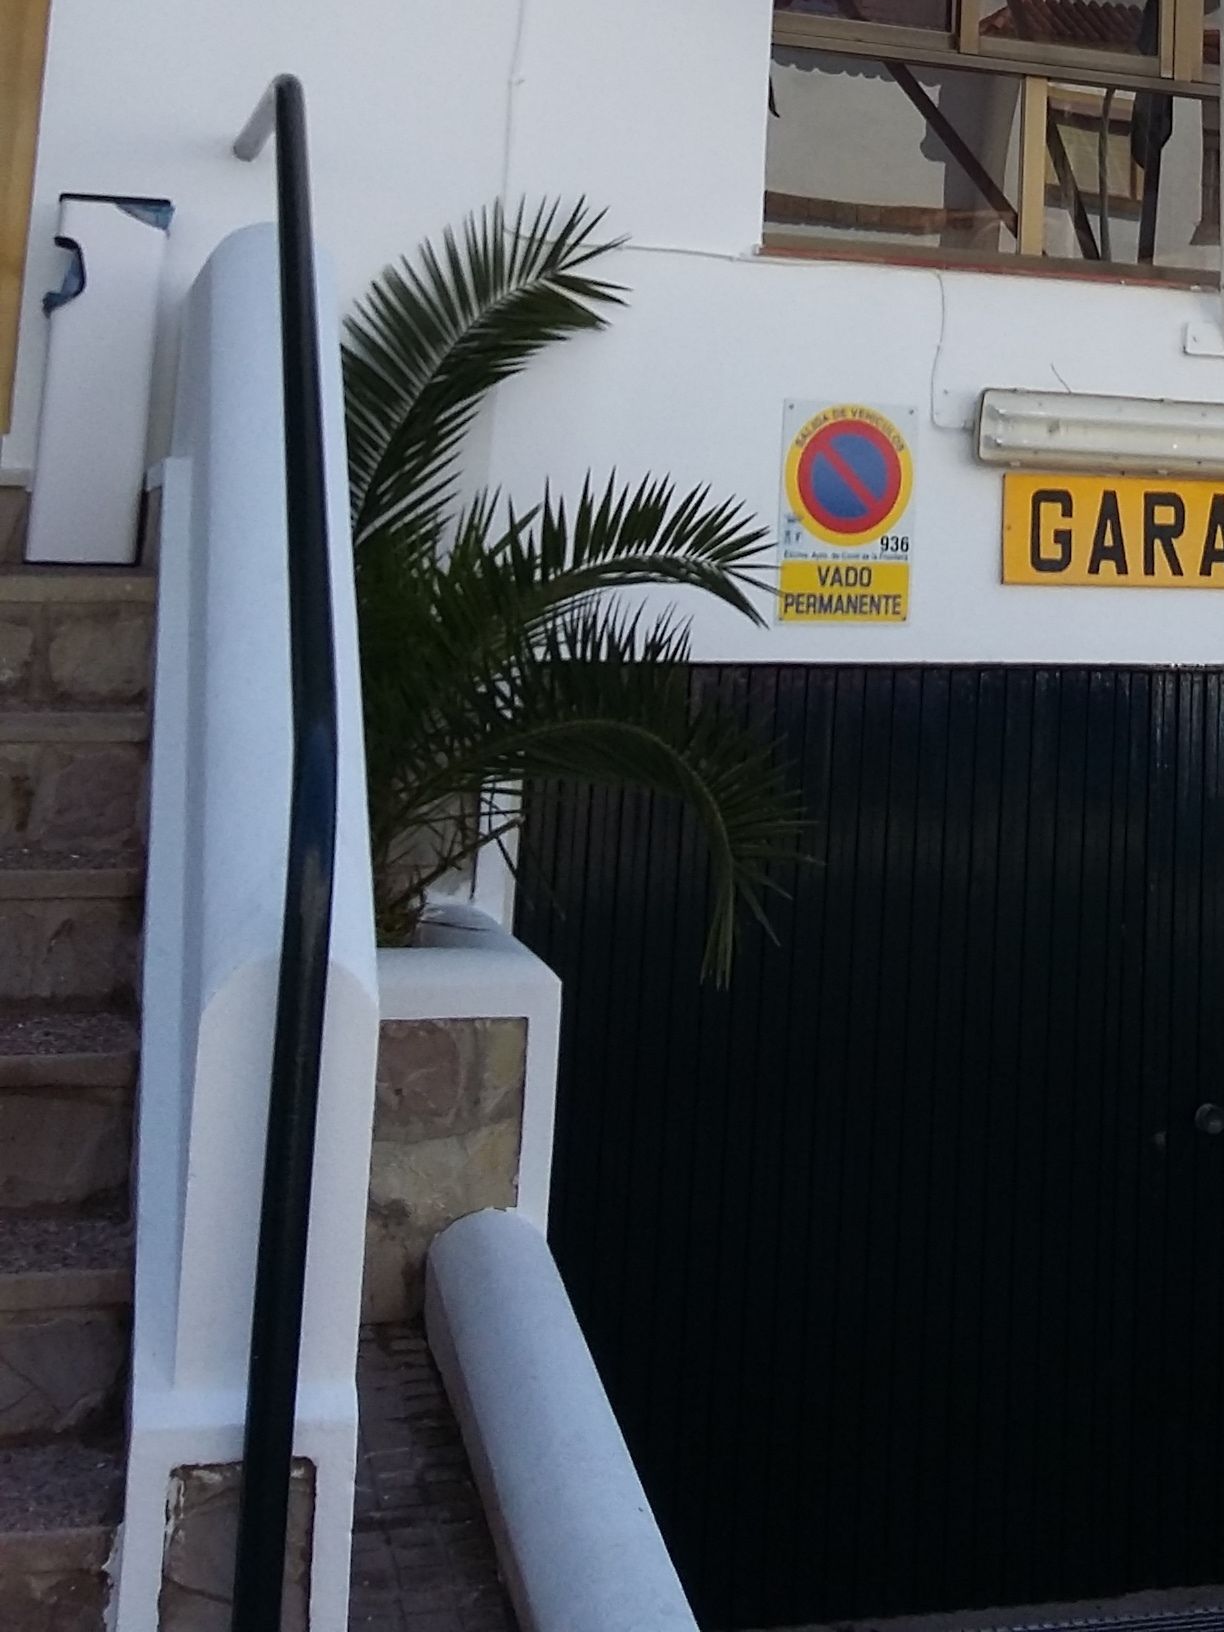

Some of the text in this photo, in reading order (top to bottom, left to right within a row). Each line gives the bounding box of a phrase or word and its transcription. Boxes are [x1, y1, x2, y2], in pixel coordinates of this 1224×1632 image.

[880, 535, 910, 553] 936
[817, 565, 873, 587] VADO
[783, 593, 902, 616] PERMANENTE
